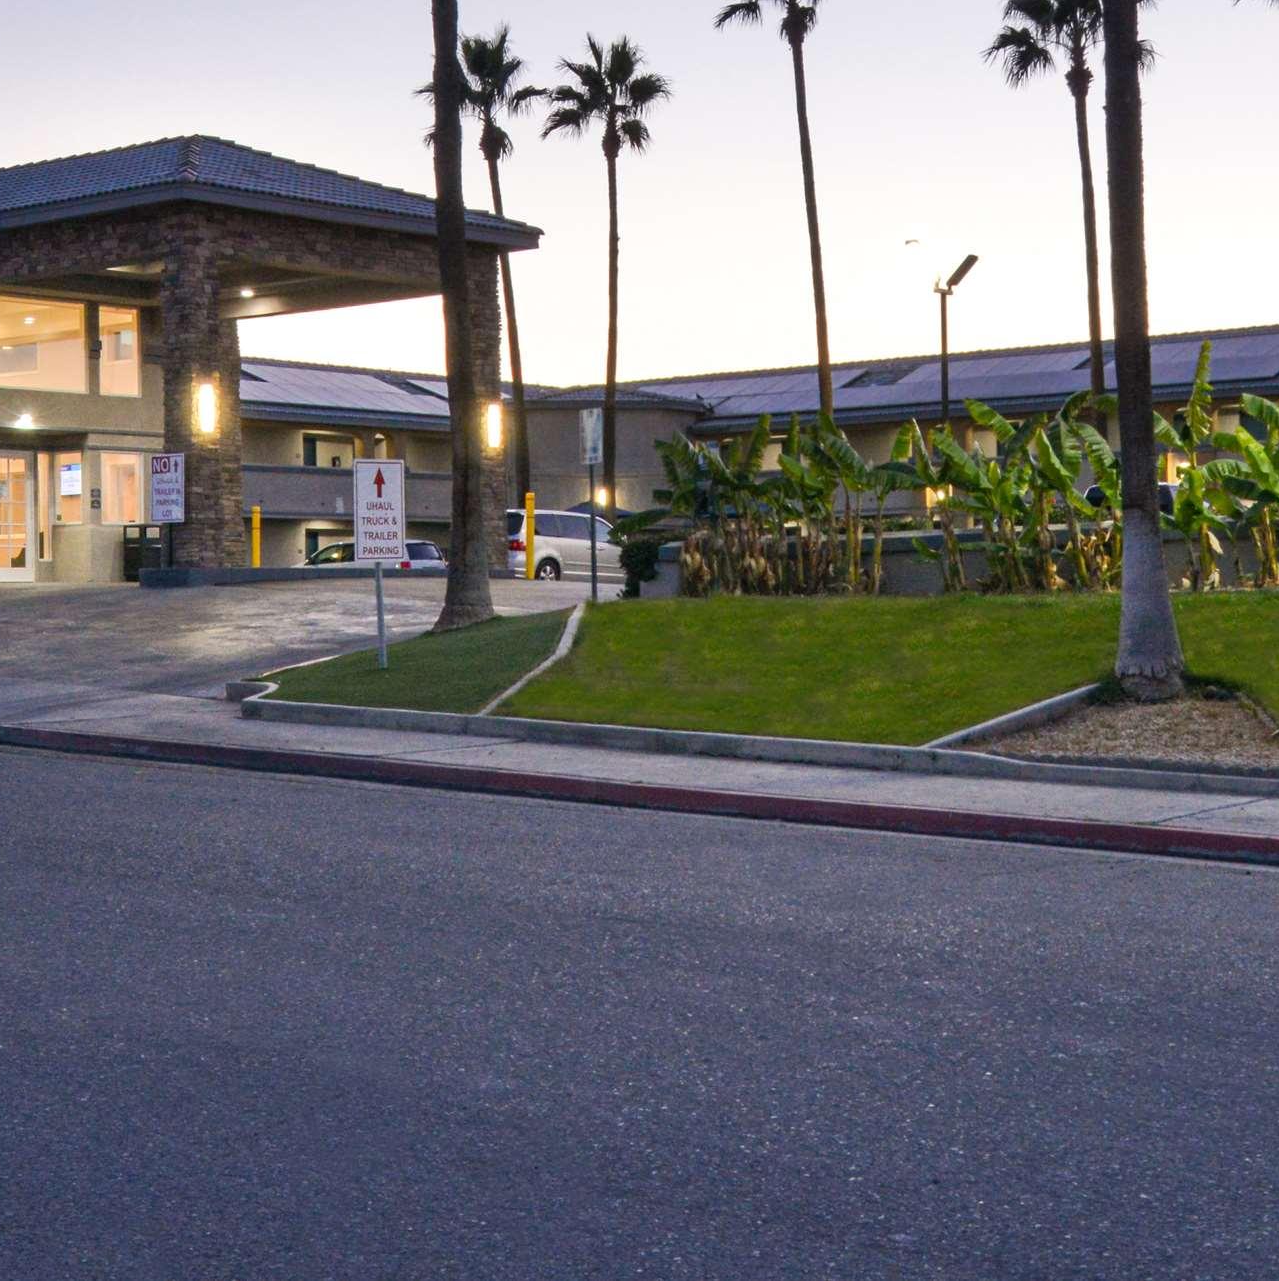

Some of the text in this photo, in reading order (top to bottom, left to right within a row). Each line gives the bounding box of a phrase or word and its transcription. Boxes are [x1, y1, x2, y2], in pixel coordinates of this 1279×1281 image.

[153, 458, 169, 473] NO
[366, 501, 395, 511] UHAUL
[361, 516, 397, 526] TRUCK &
[363, 531, 398, 541] TRAILER
[362, 546, 400, 555] PARKING
